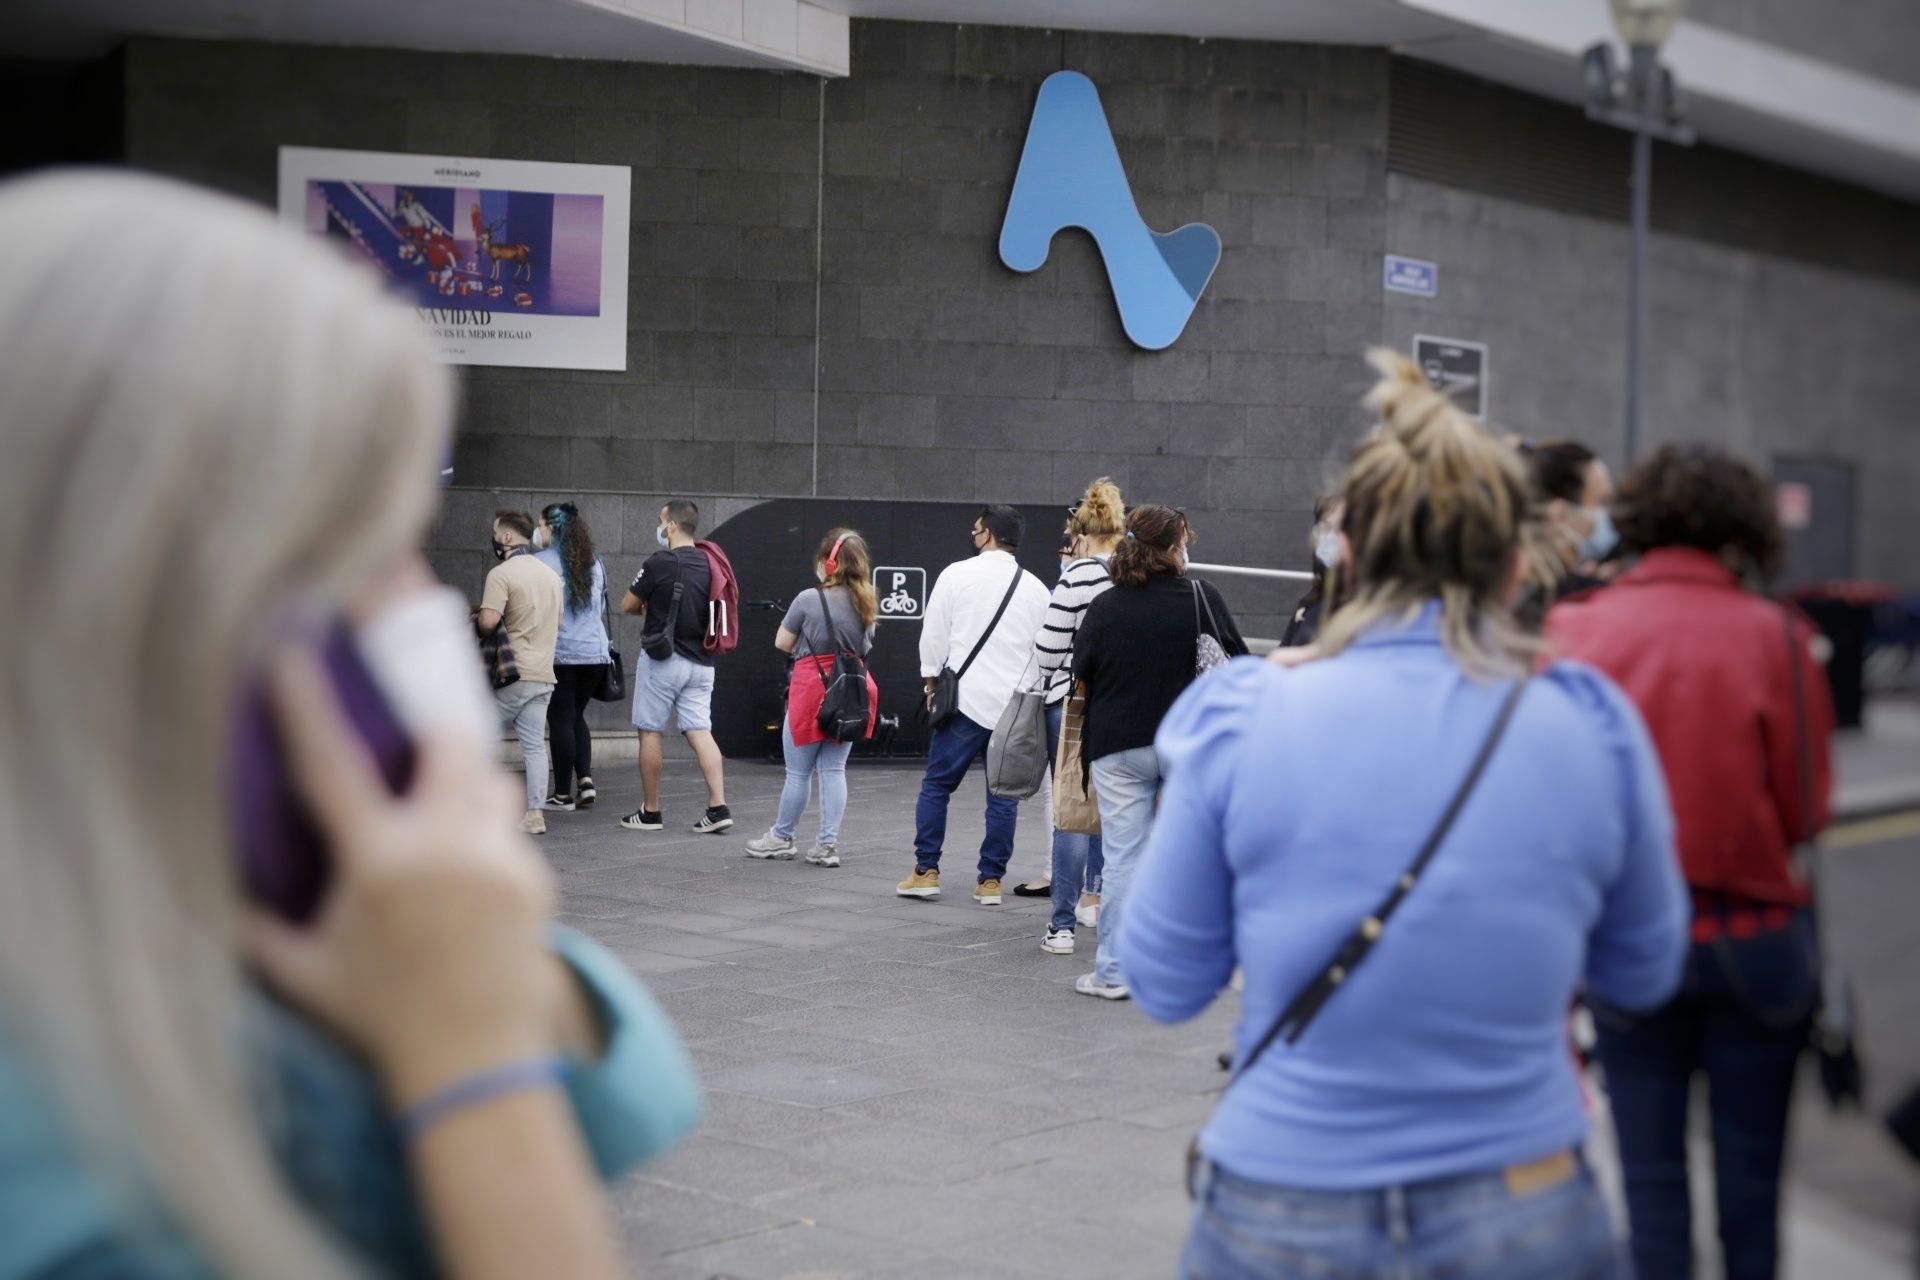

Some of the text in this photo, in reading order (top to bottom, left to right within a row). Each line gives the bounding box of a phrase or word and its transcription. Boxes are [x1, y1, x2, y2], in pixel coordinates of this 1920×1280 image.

[416, 307, 492, 326] NAVIDAD
[468, 329, 496, 341] MEJOR
[498, 330, 532, 340] REGALO
[892, 572, 907, 591] P
